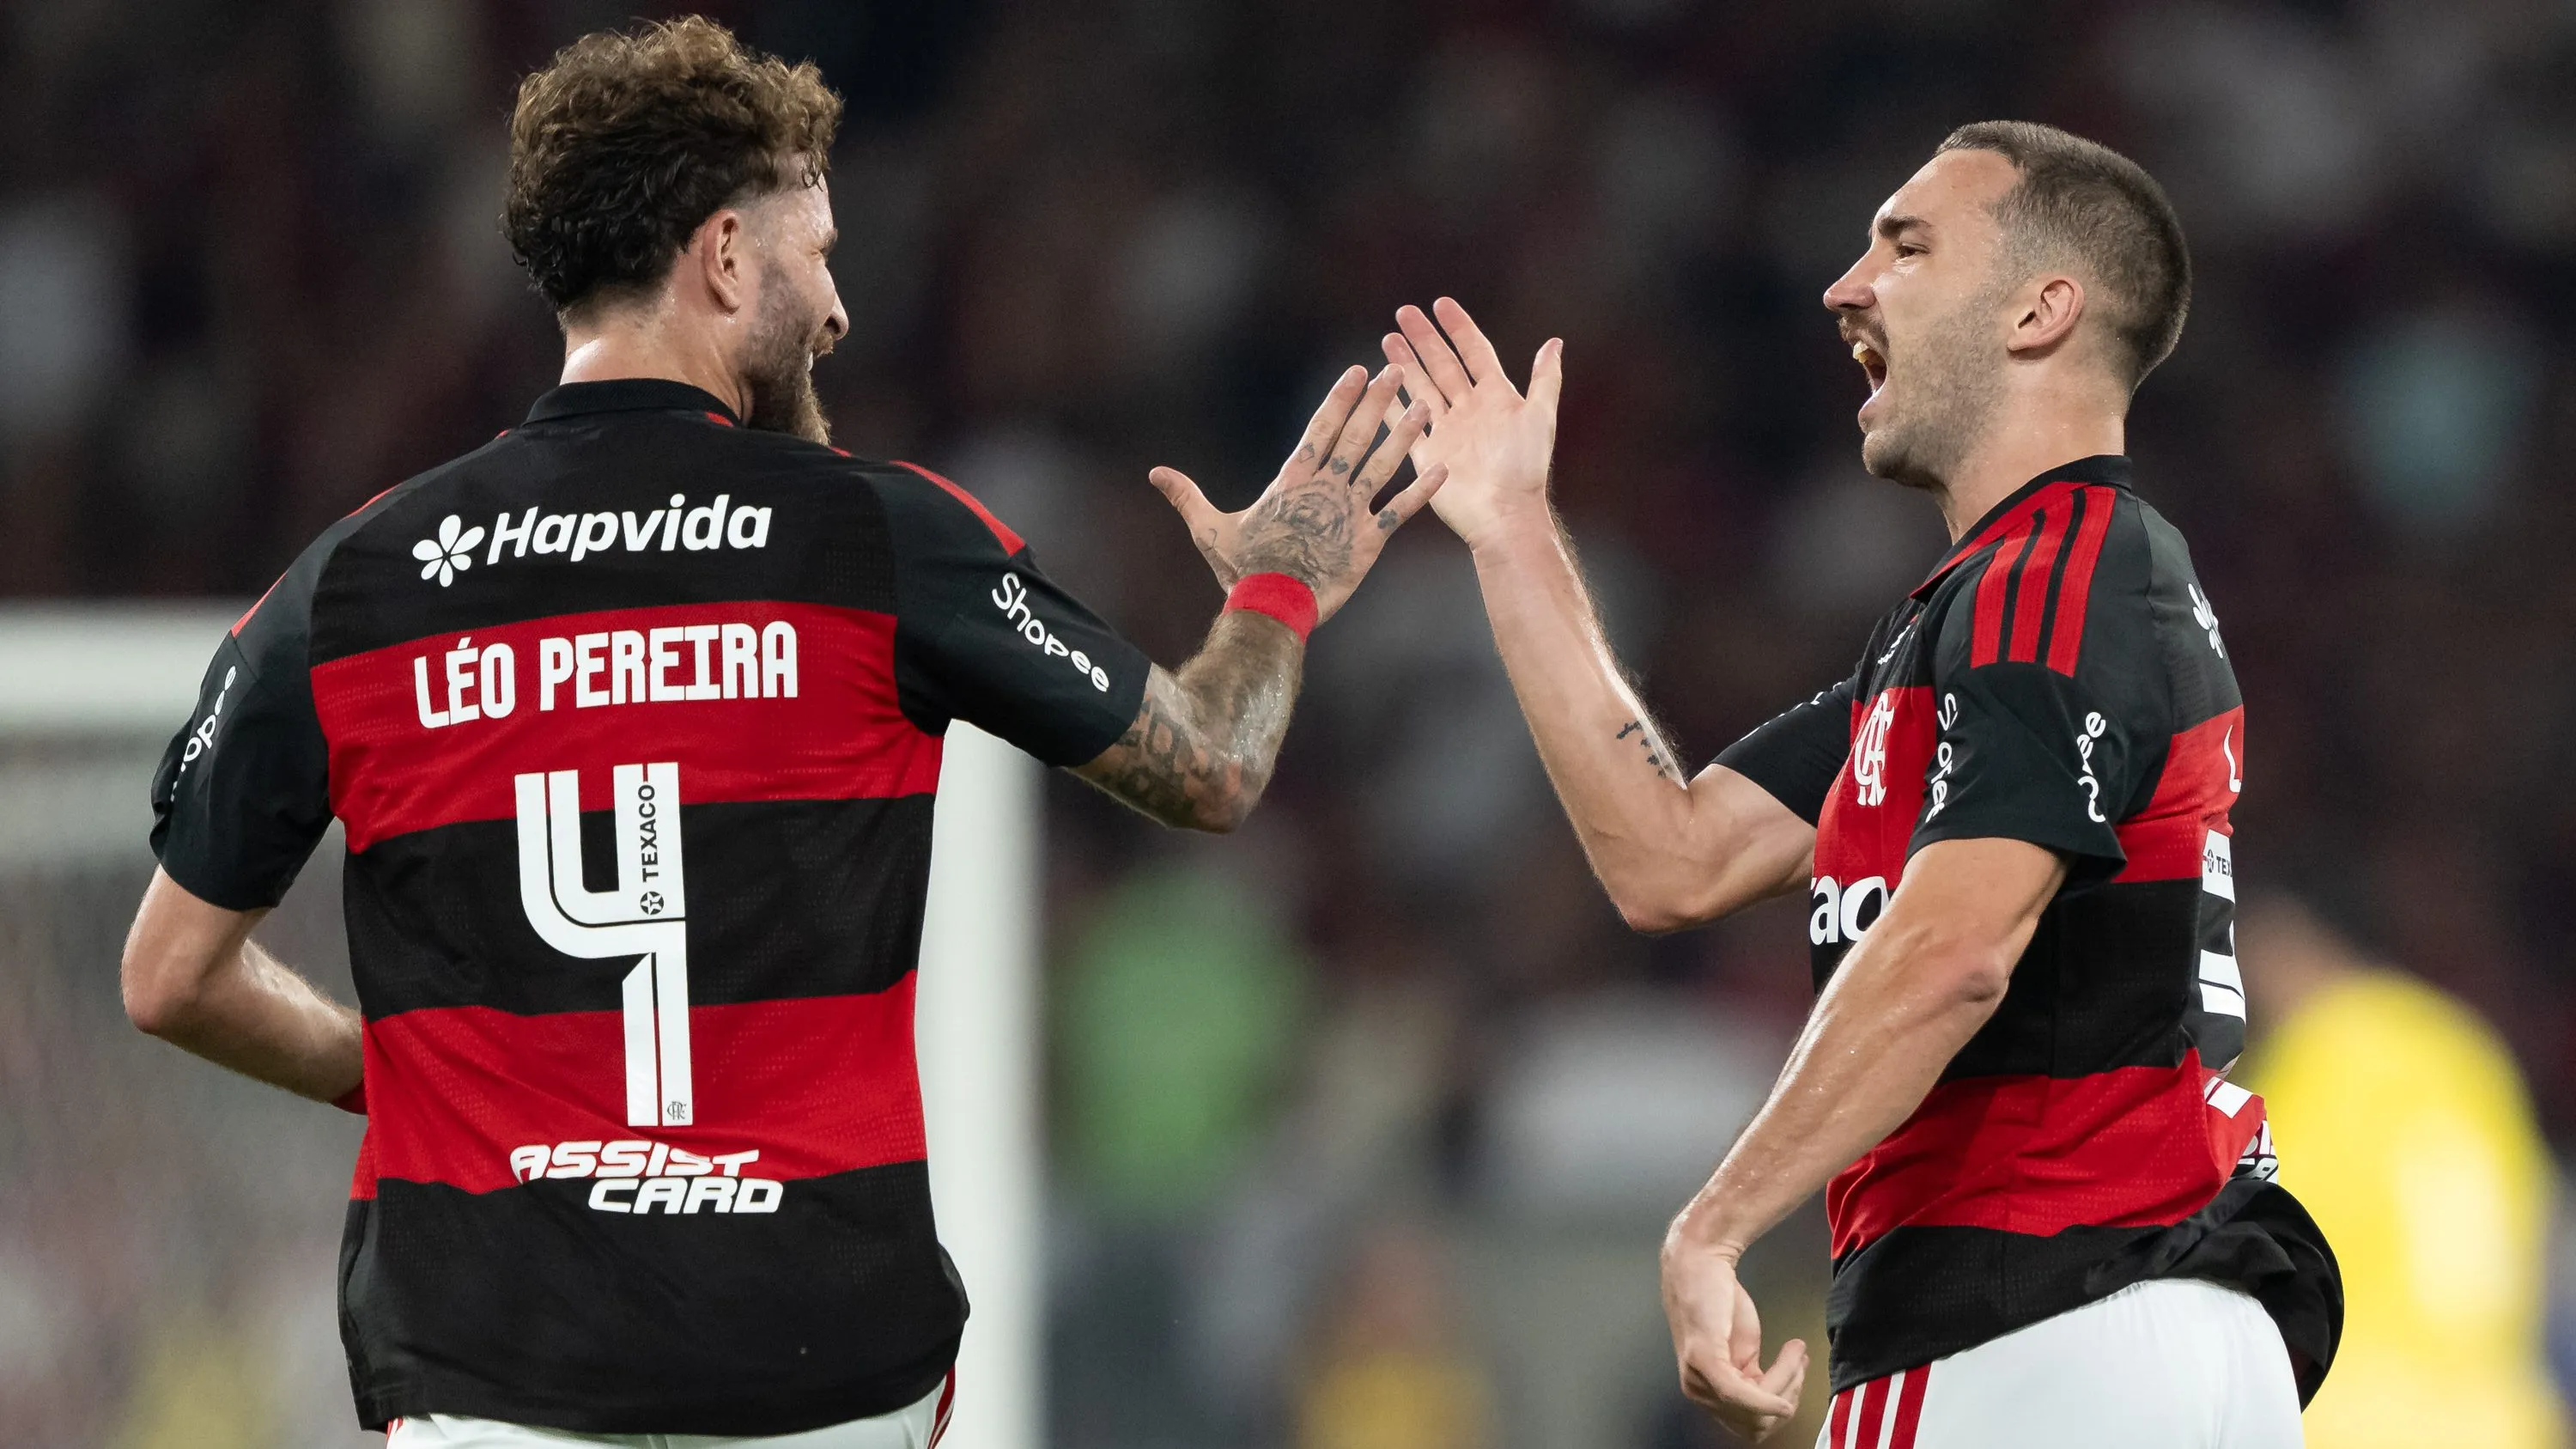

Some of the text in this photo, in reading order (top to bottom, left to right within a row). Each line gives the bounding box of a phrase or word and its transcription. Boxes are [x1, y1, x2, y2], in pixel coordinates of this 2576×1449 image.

[486, 493, 772, 566] Hapvida
[414, 620, 799, 729] LÉO PEREIRA
[991, 572, 1110, 692] Shopee
[171, 665, 237, 802] opee
[637, 784, 659, 883] TEXACO
[514, 761, 694, 1127] 4
[509, 1140, 760, 1184] ASSIST
[587, 1178, 784, 1215] CARD
